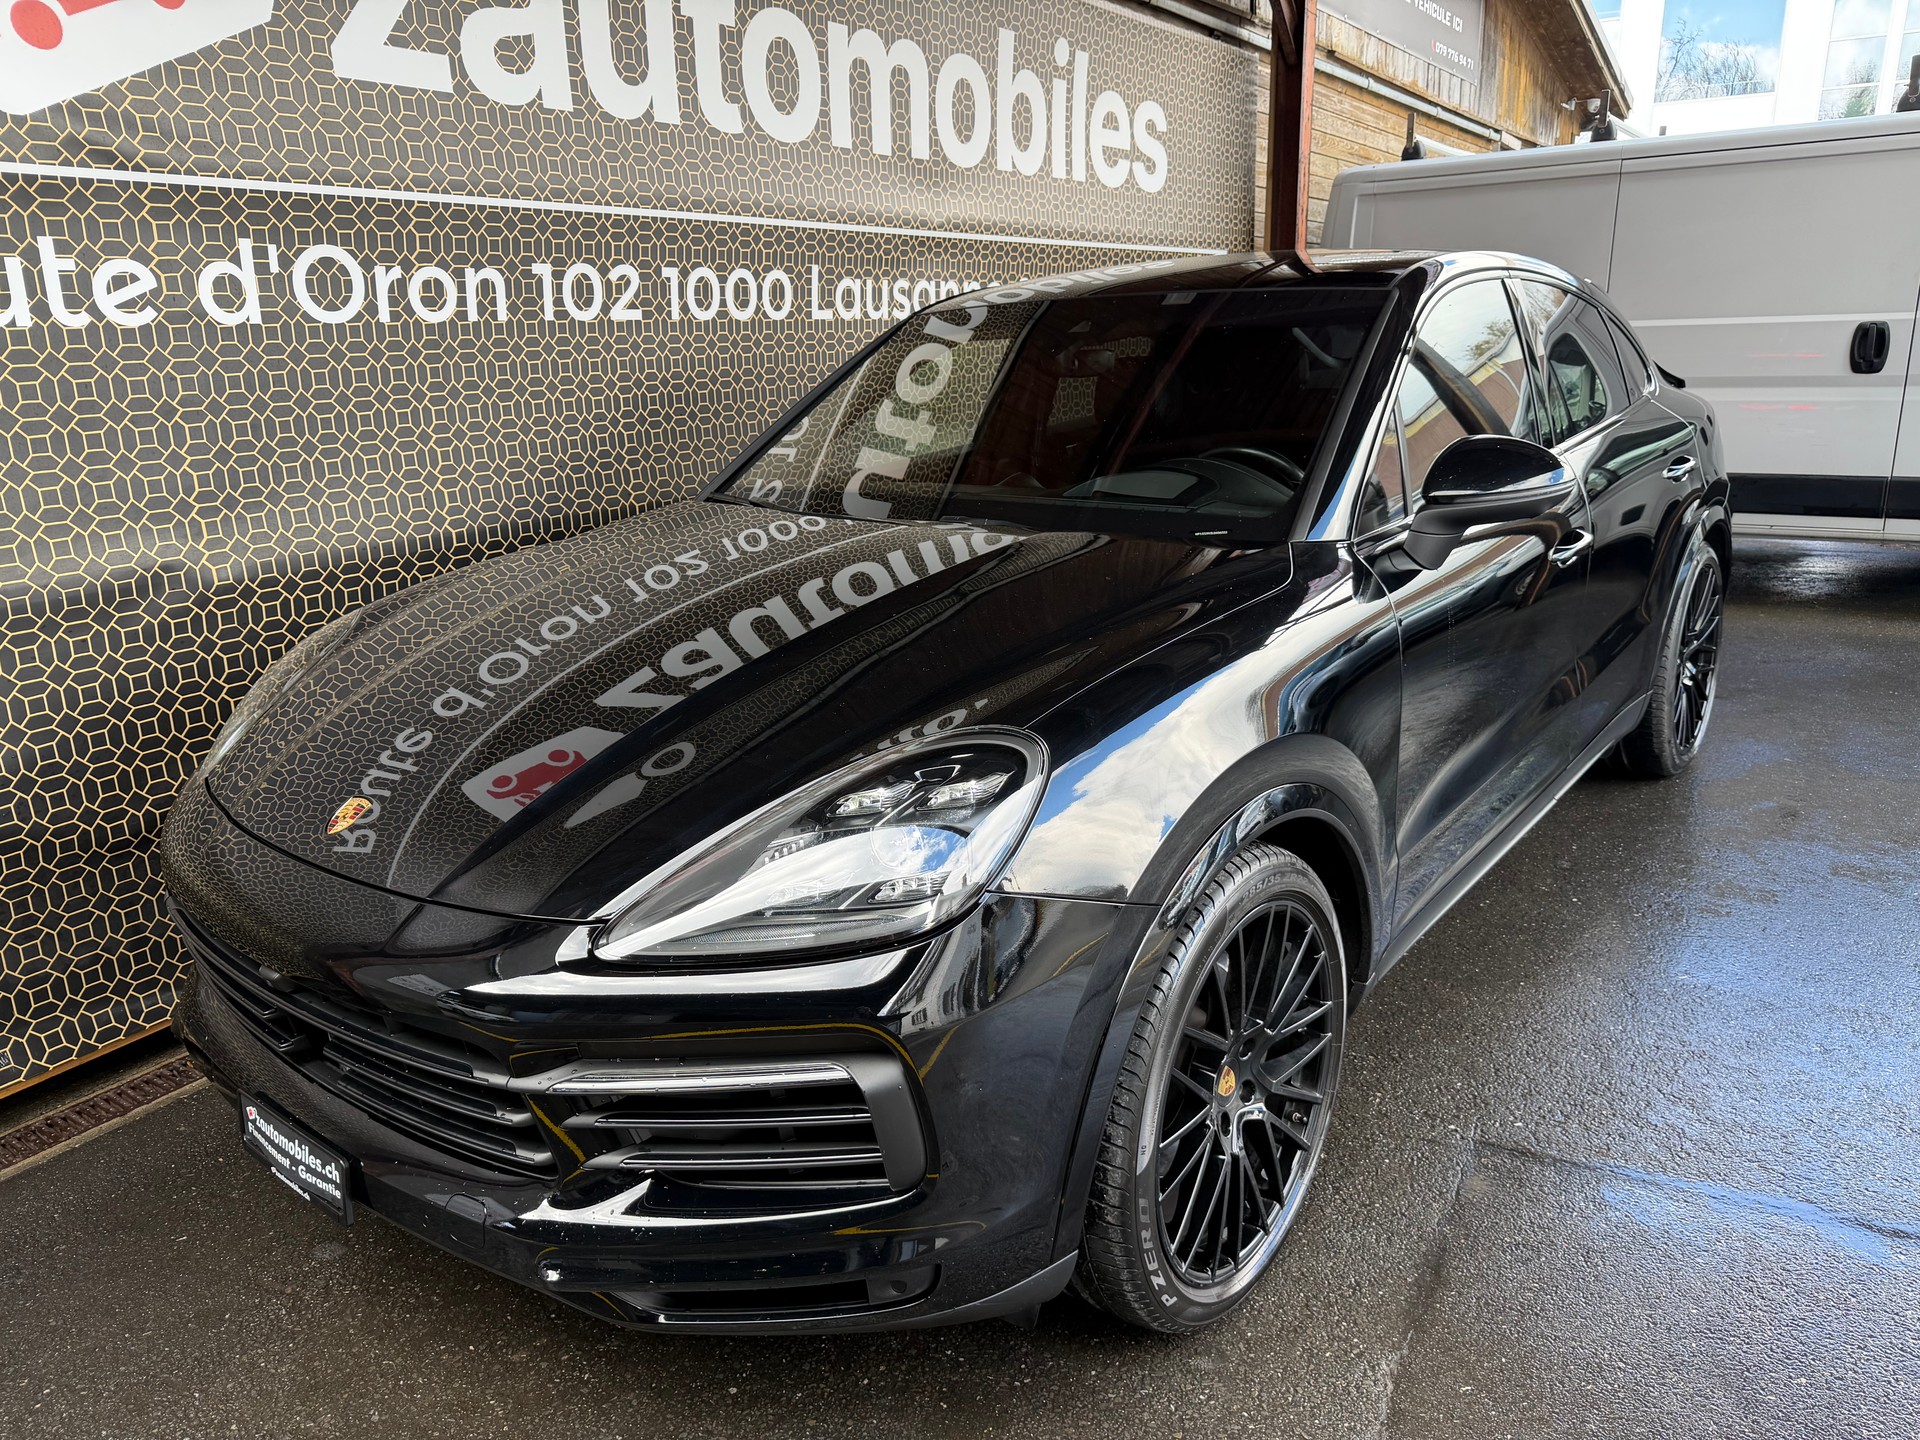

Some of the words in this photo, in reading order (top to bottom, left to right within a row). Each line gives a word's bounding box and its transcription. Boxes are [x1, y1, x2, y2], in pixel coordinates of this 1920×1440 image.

[1435, 41, 1447, 56] 079
[1448, 48, 1459, 63] 776
[1459, 54, 1467, 67] 94
[1467, 58, 1474, 70] 71
[1452, 15, 1462, 33] ICI
[330, 0, 1168, 193] zautomobiles
[198, 237, 508, 325] d'Oron
[532, 263, 642, 321] 102
[662, 266, 792, 321] 1000
[811, 264, 1000, 321] Lausa
[248, 1121, 290, 1169] Financement
[298, 1165, 341, 1199] Garantie
[256, 1115, 340, 1183] zautomobiles.ch
